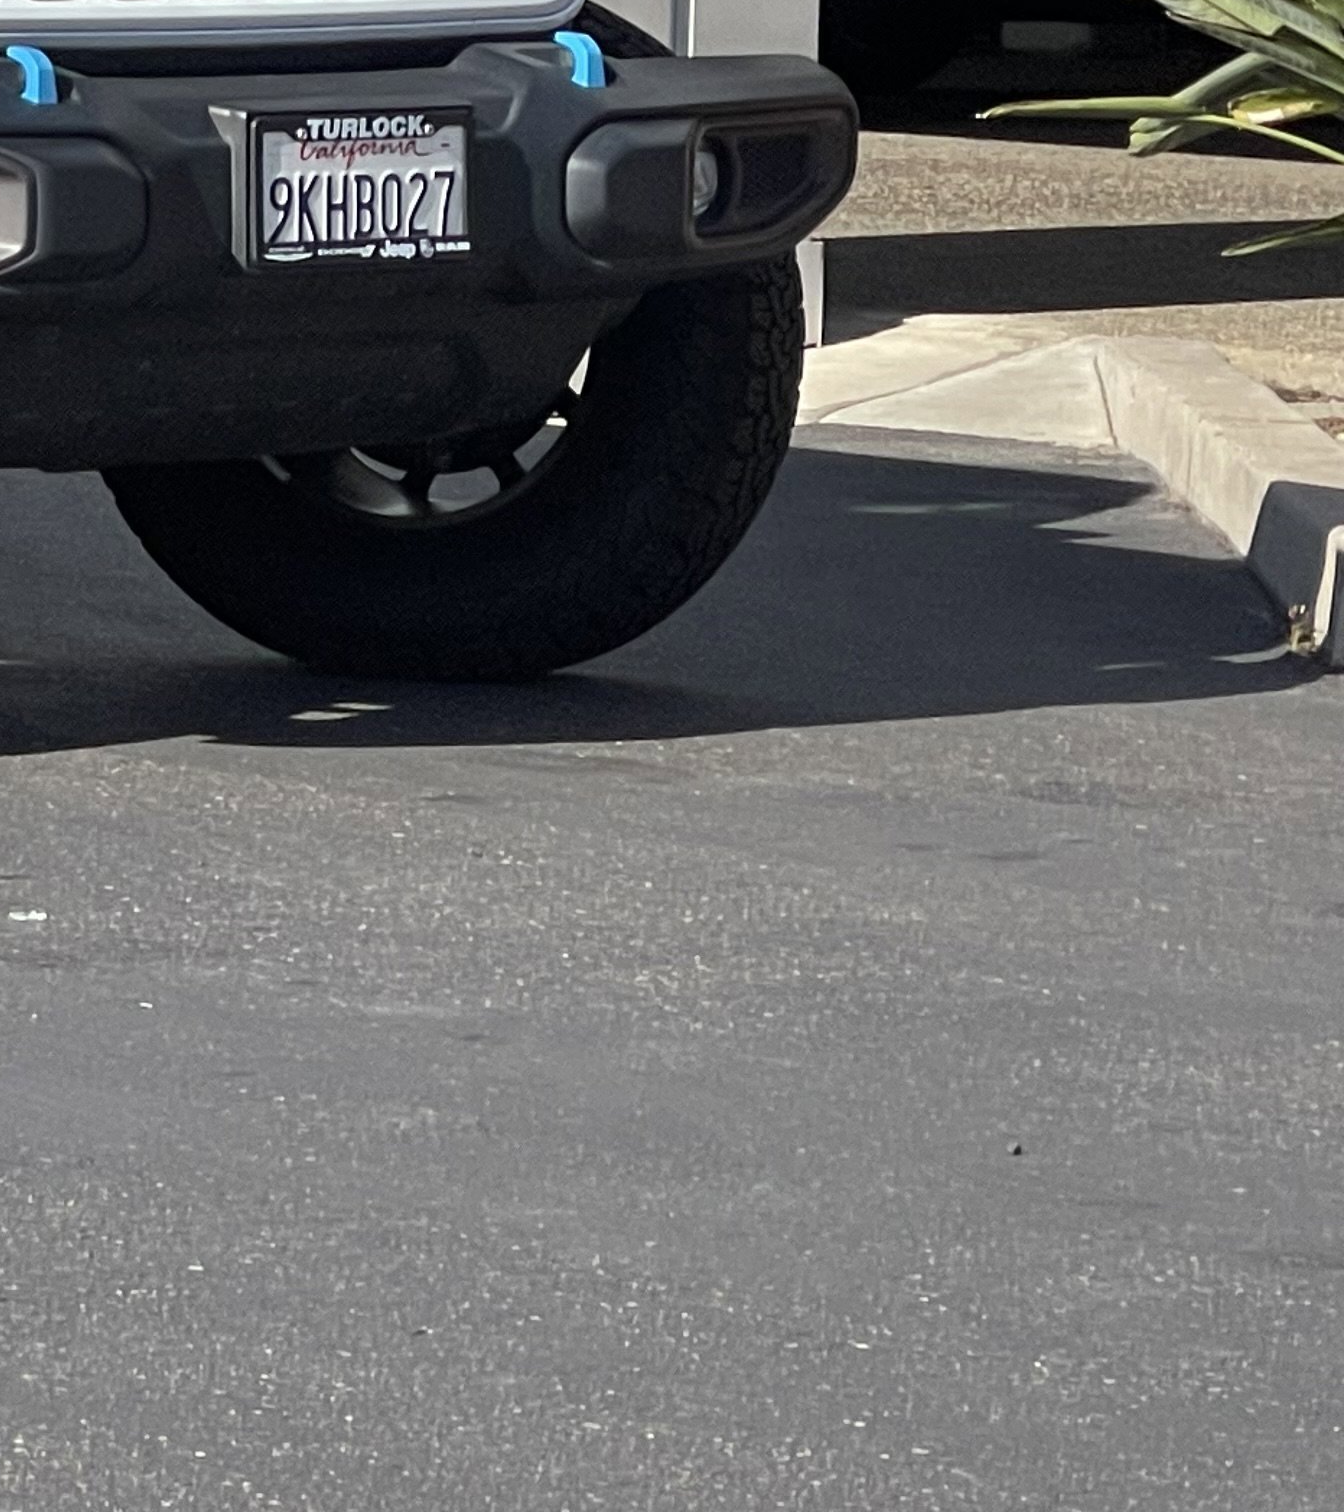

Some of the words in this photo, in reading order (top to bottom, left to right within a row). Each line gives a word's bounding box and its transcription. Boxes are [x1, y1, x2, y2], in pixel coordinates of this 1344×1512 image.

[307, 114, 426, 140] TURLOCK
[299, 139, 431, 169] California
[269, 170, 455, 244] 9KHB027
